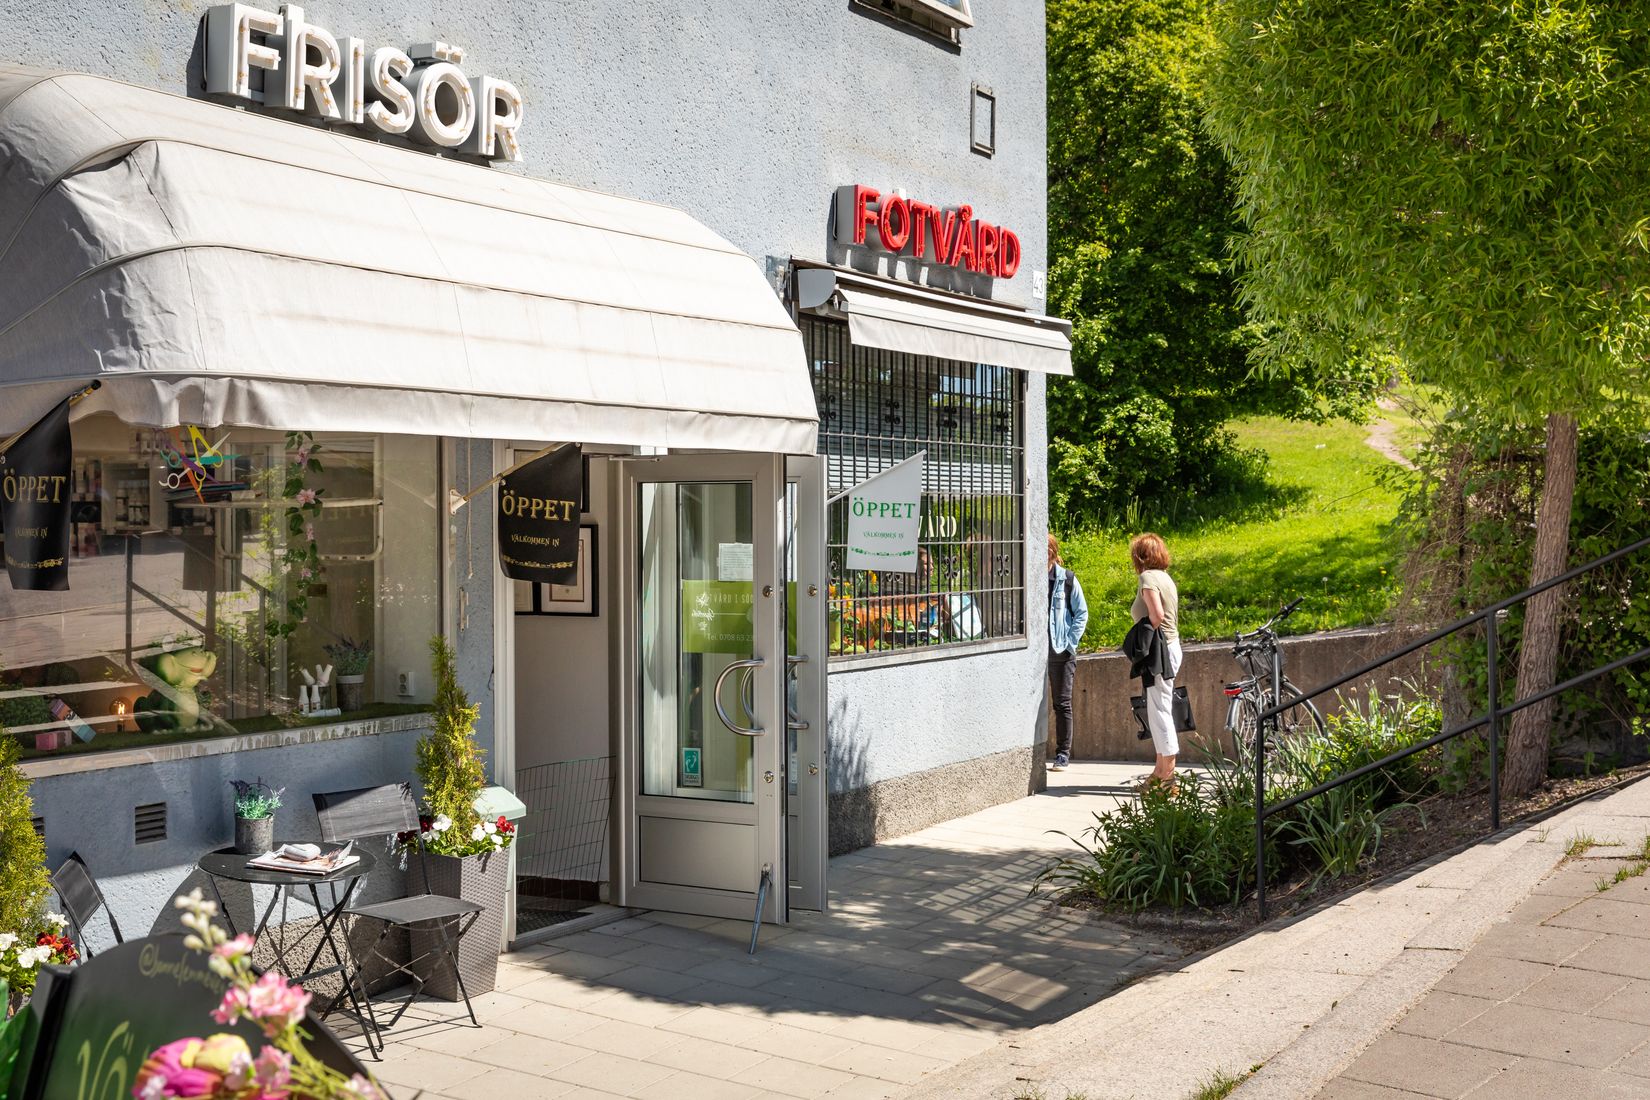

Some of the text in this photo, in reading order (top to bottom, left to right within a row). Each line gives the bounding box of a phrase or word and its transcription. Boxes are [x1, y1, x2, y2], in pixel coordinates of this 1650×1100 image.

[212, 2, 524, 162] FRISÖR
[851, 184, 1021, 279] FOTVÅRD
[1033, 275, 1043, 294] 43
[3, 468, 66, 504] ÖPPET
[502, 489, 576, 522] ÖPPET
[852, 497, 916, 519] ÖPPET
[552, 538, 560, 547] IN
